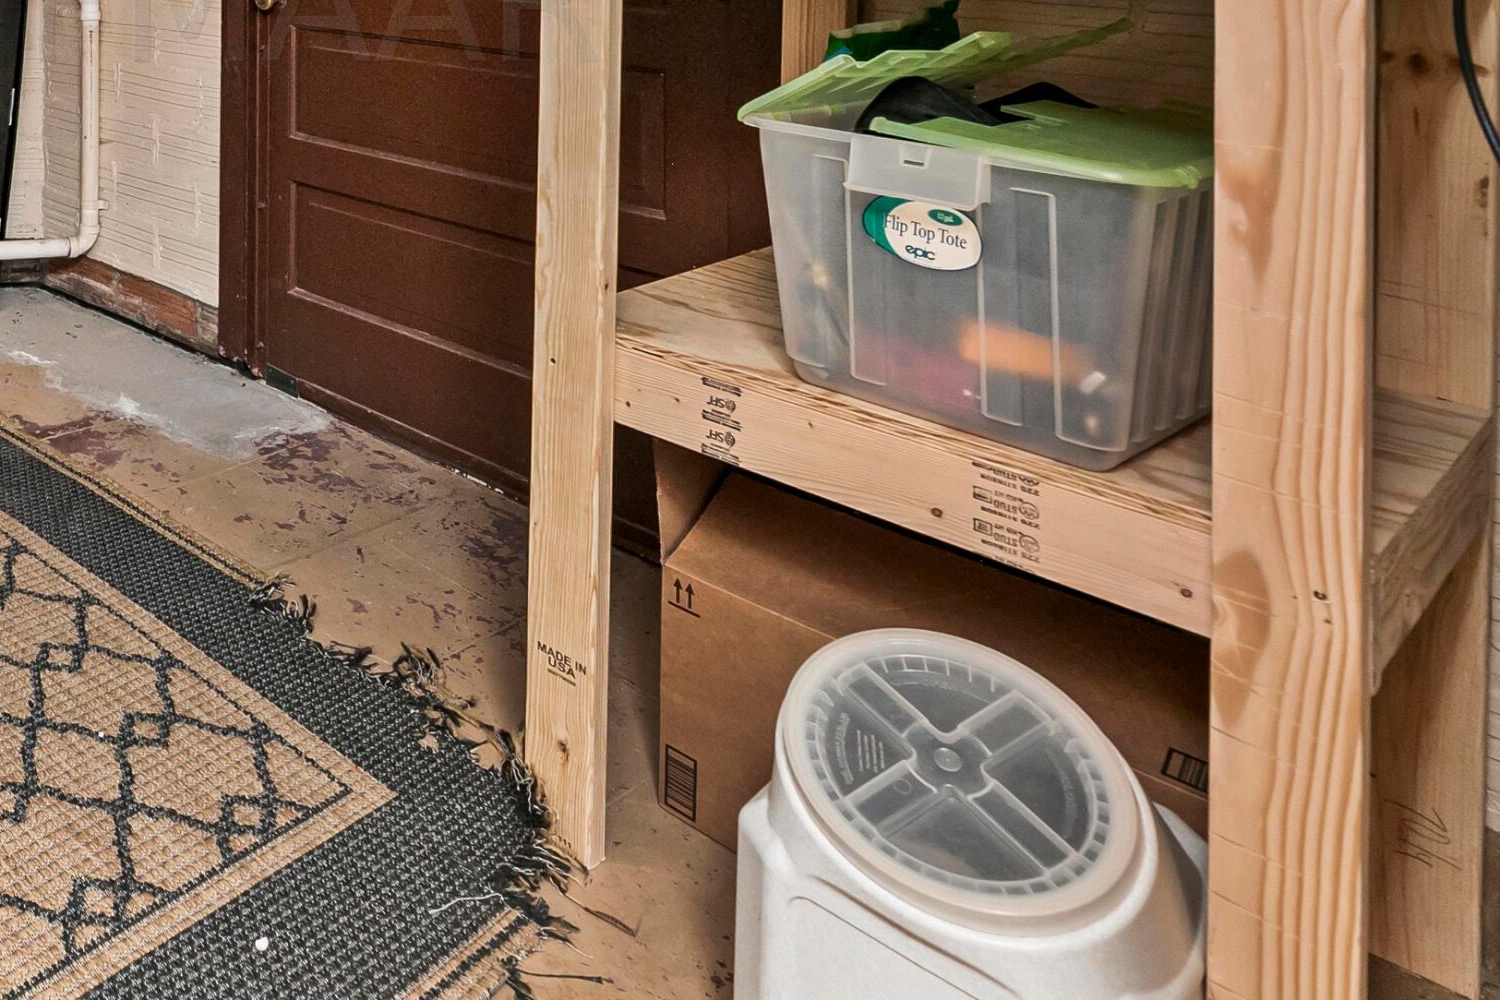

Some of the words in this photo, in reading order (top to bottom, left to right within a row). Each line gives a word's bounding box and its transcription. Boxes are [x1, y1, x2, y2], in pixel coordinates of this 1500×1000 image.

[884, 213, 908, 236] Flip
[911, 220, 935, 244] Top
[938, 228, 967, 249] Tote
[905, 244, 935, 261] epic
[537, 640, 572, 668] MADE
[575, 660, 587, 676] IN
[547, 655, 576, 680] USA
